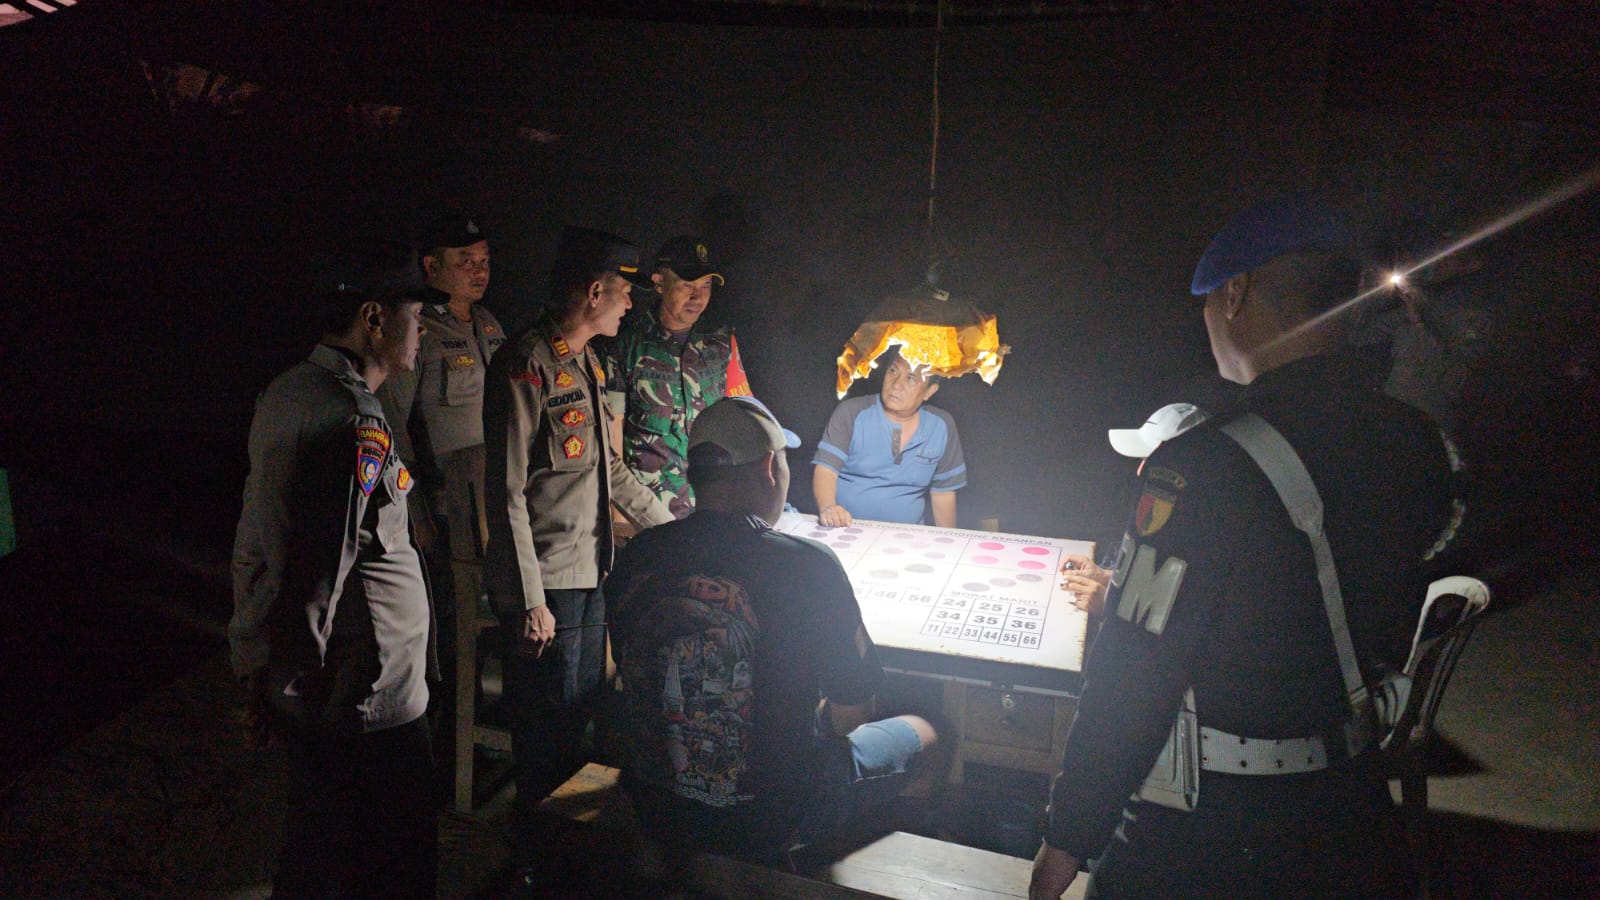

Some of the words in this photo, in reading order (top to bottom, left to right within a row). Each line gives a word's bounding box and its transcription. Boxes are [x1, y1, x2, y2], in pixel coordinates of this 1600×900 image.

[873, 589, 898, 600] 46
[908, 593, 932, 604] 56
[944, 598, 967, 608] 24
[978, 602, 1003, 612] 25
[1015, 606, 1040, 617] 26
[935, 610, 961, 621] 34
[973, 614, 999, 625] 35
[1010, 619, 1037, 630] 36
[927, 624, 939, 633] 11
[944, 626, 960, 636] 22
[963, 628, 979, 638] 33
[983, 630, 998, 641] 44
[1002, 633, 1018, 643] 55
[1022, 635, 1037, 645] 66
